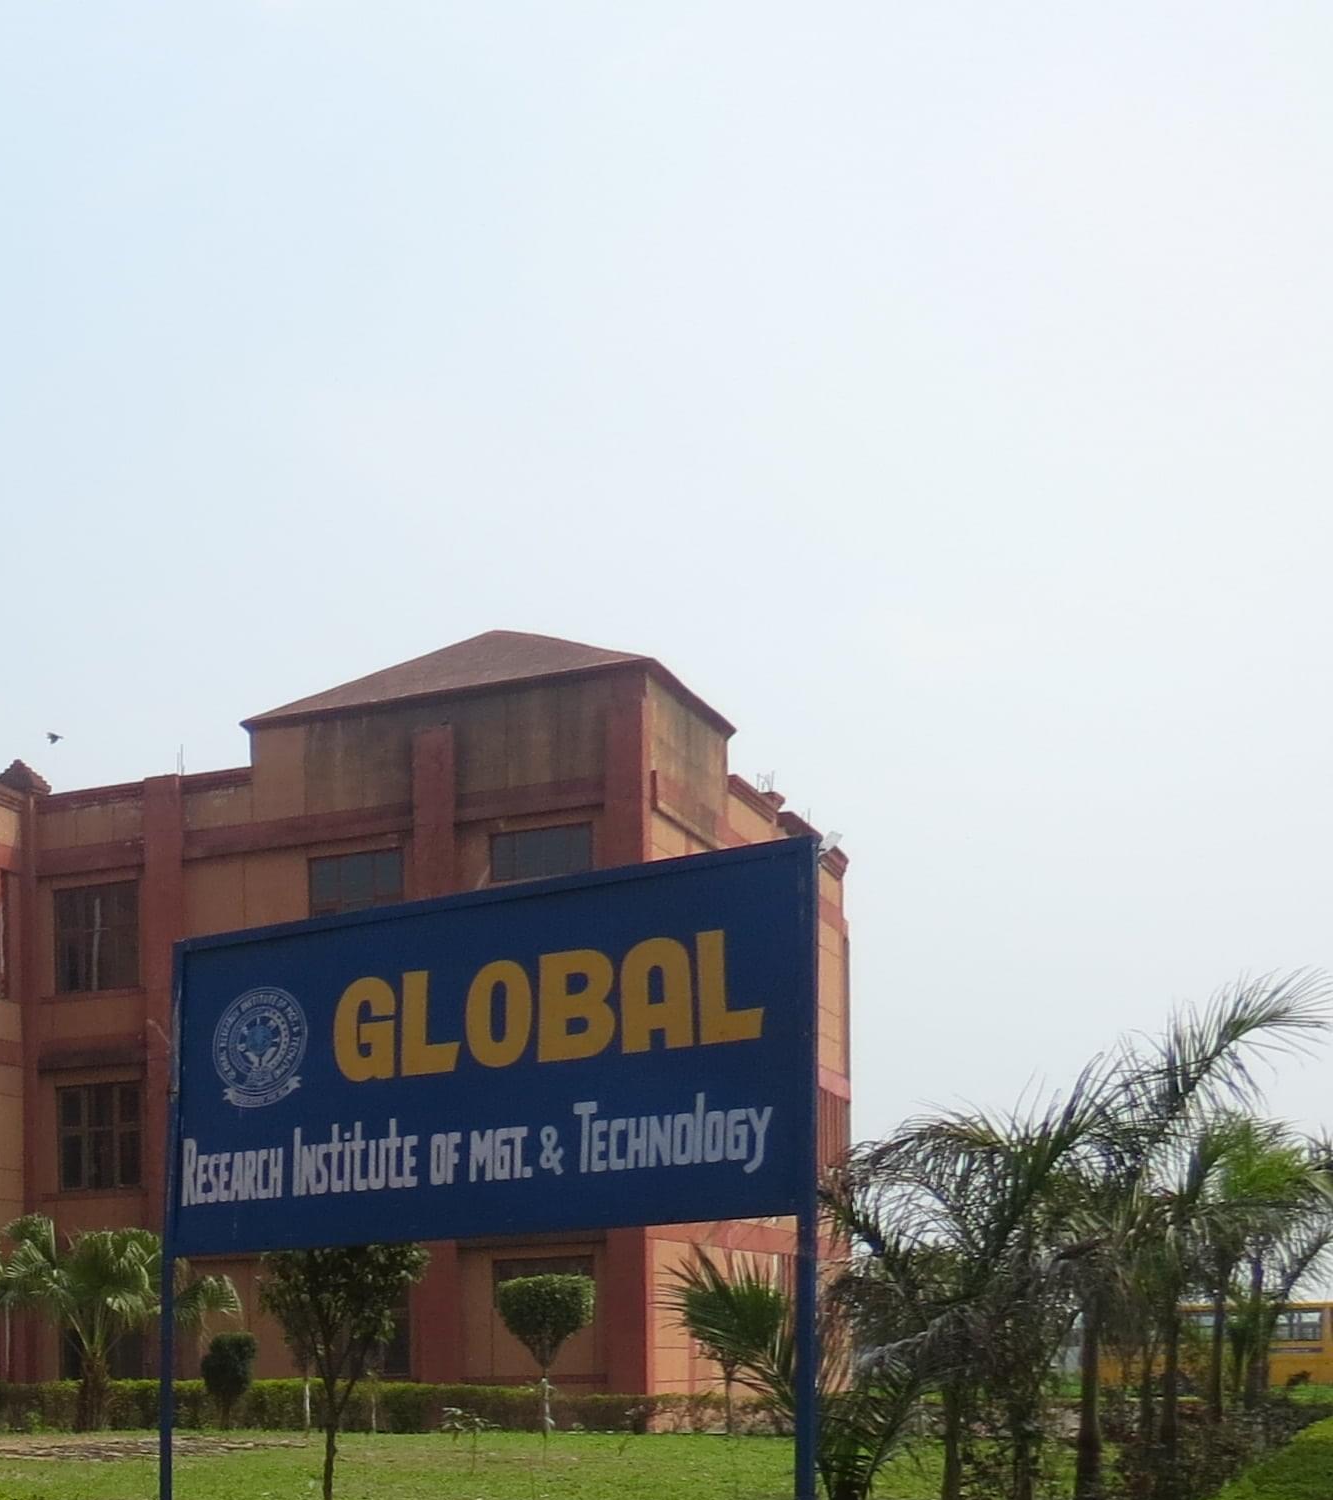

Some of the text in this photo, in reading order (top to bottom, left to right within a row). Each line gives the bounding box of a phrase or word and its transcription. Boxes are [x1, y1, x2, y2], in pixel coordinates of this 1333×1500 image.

[334, 929, 765, 1082] GLOBAL
[430, 1132, 462, 1186] OF
[469, 1126, 533, 1183] MGT.
[539, 1125, 564, 1175] &
